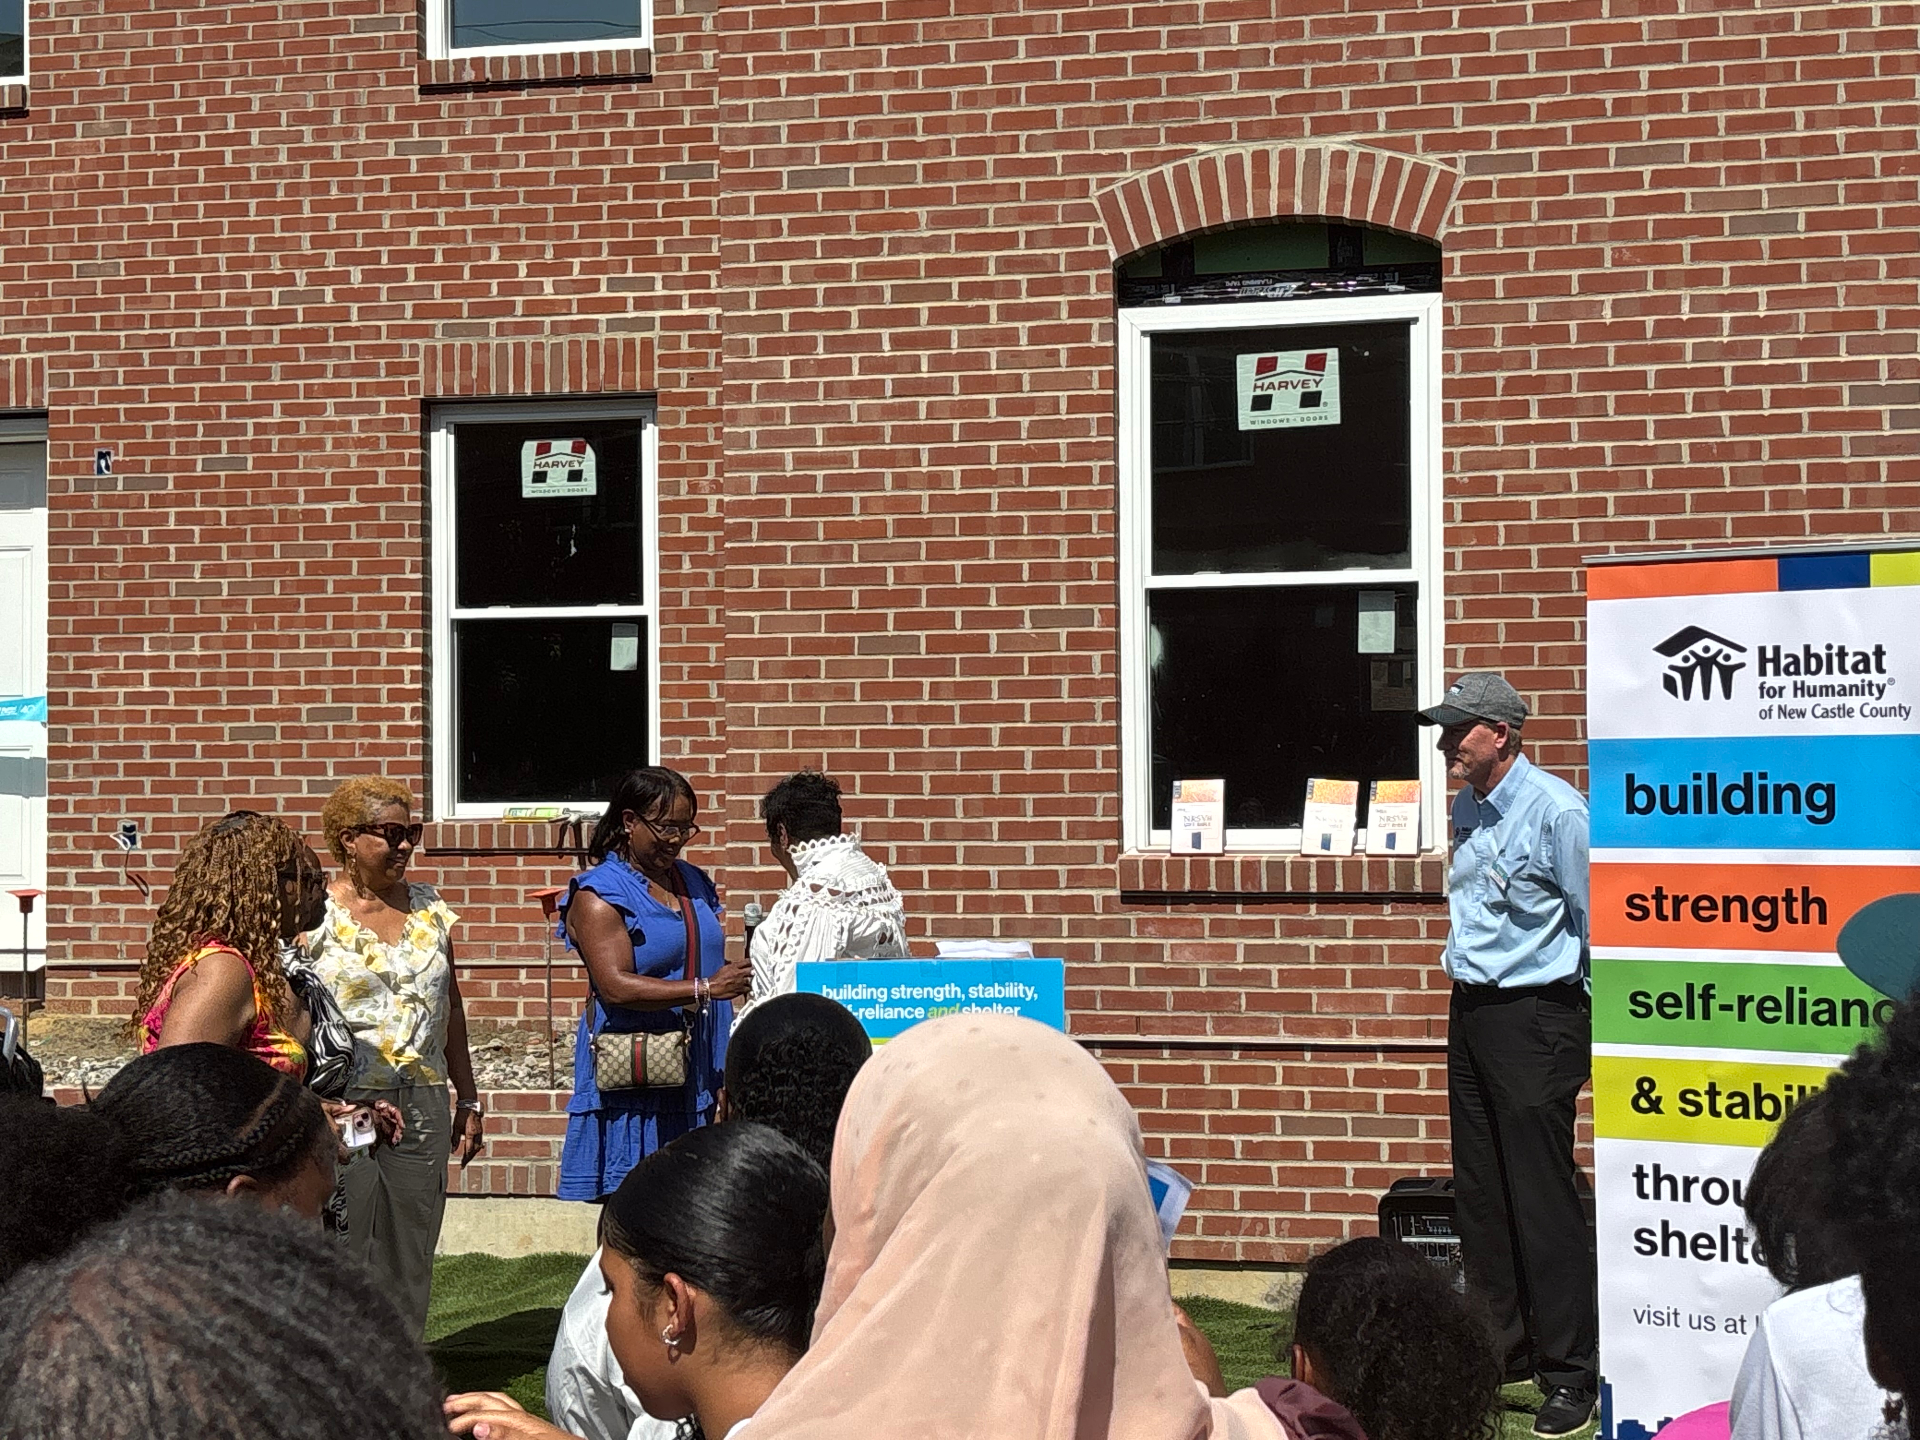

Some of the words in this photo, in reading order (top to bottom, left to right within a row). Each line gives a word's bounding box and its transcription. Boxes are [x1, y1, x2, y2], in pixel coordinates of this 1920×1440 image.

[1253, 378, 1324, 393] HARVEY
[533, 460, 585, 469] HARVEY
[1757, 643, 1887, 677] Habitat
[1758, 681, 1787, 699] for
[1758, 705, 1773, 720] of
[1778, 704, 1807, 720] New
[1812, 702, 1855, 719] Castle
[1860, 702, 1912, 721] County
[1625, 771, 1837, 825] building
[1625, 885, 1828, 933] strength
[822, 983, 888, 1003] building
[890, 983, 966, 1002] strength,
[968, 982, 1038, 1002] stability,
[1628, 982, 1897, 1028] self-relianc
[843, 1003, 925, 1020] f-reliance
[928, 1003, 960, 1018] and
[962, 1002, 1022, 1017] shelter
[1630, 1076, 1665, 1115] &
[1632, 1163, 1744, 1207] throu
[1633, 1219, 1767, 1267] shelte
[1633, 1305, 1681, 1328] visit
[1689, 1313, 1717, 1332] us
[1724, 1314, 1748, 1335] at
